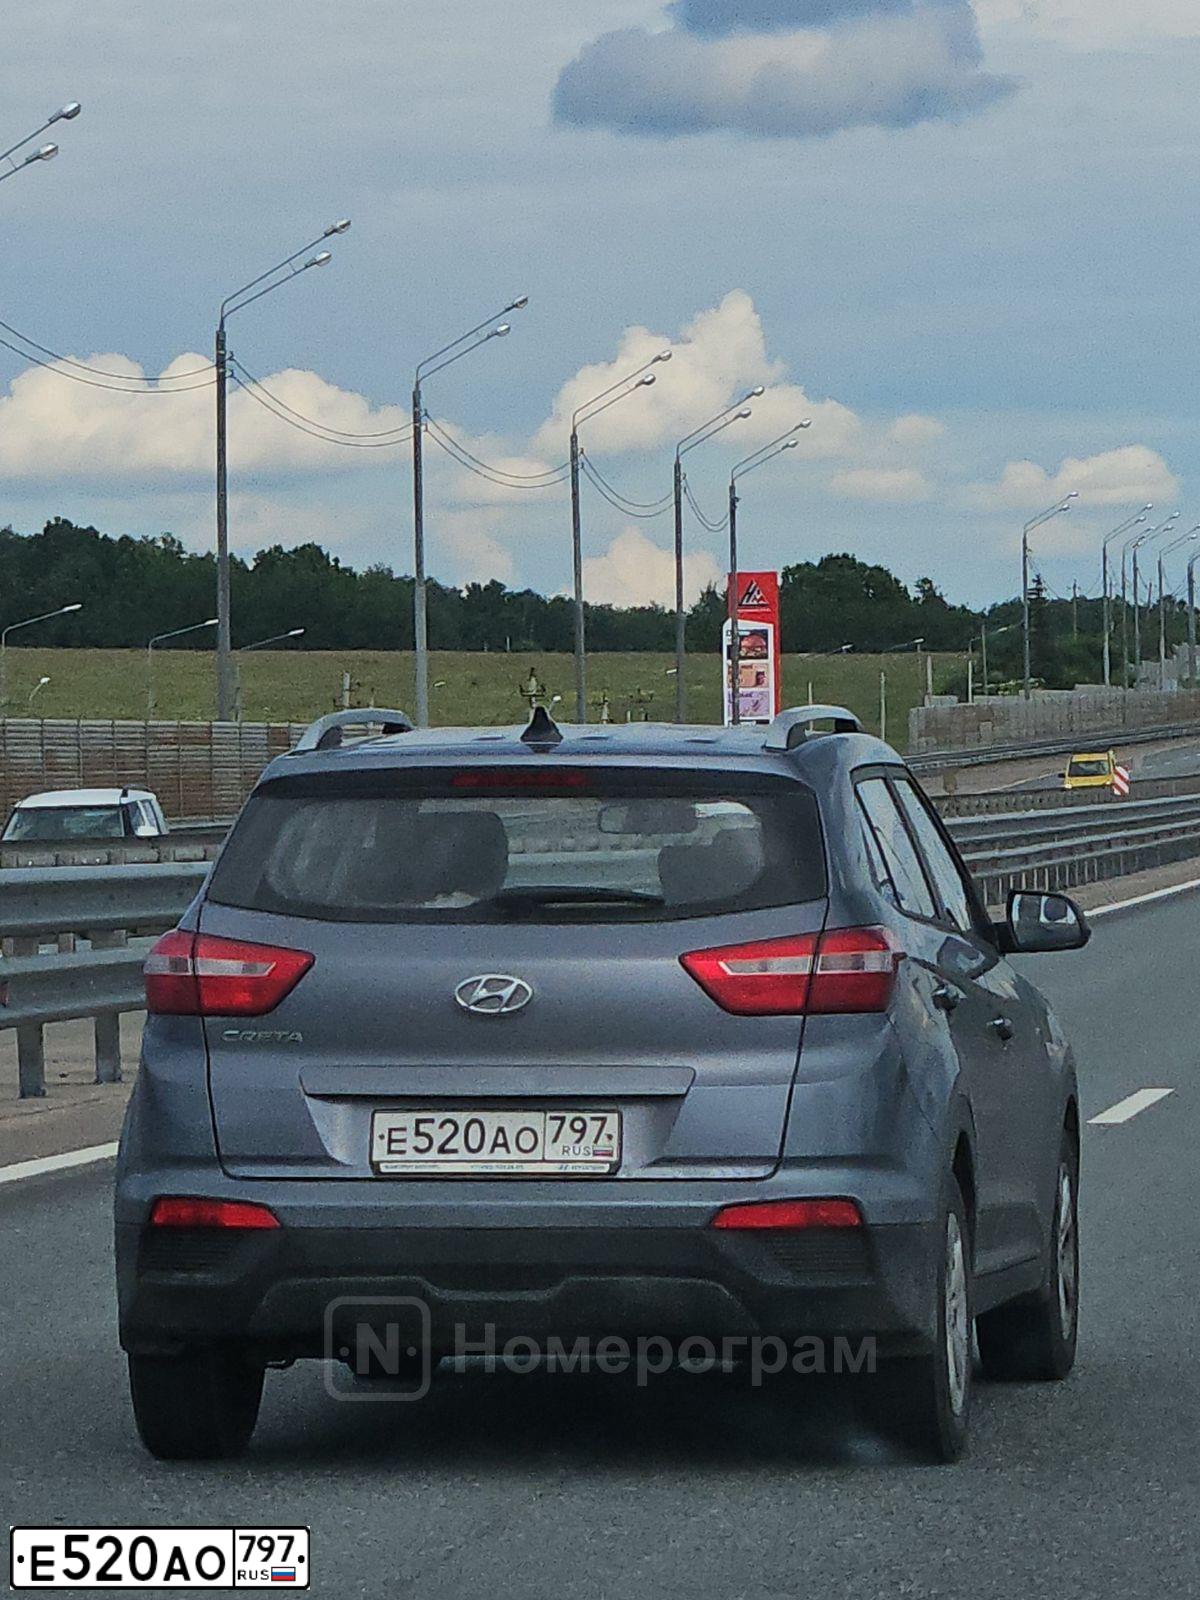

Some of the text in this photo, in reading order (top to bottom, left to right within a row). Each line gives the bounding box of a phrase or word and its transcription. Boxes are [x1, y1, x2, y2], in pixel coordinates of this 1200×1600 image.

[387, 1118, 539, 1155] Е520АО
[548, 1116, 608, 1144] 797
[562, 1145, 591, 1156] RUS
